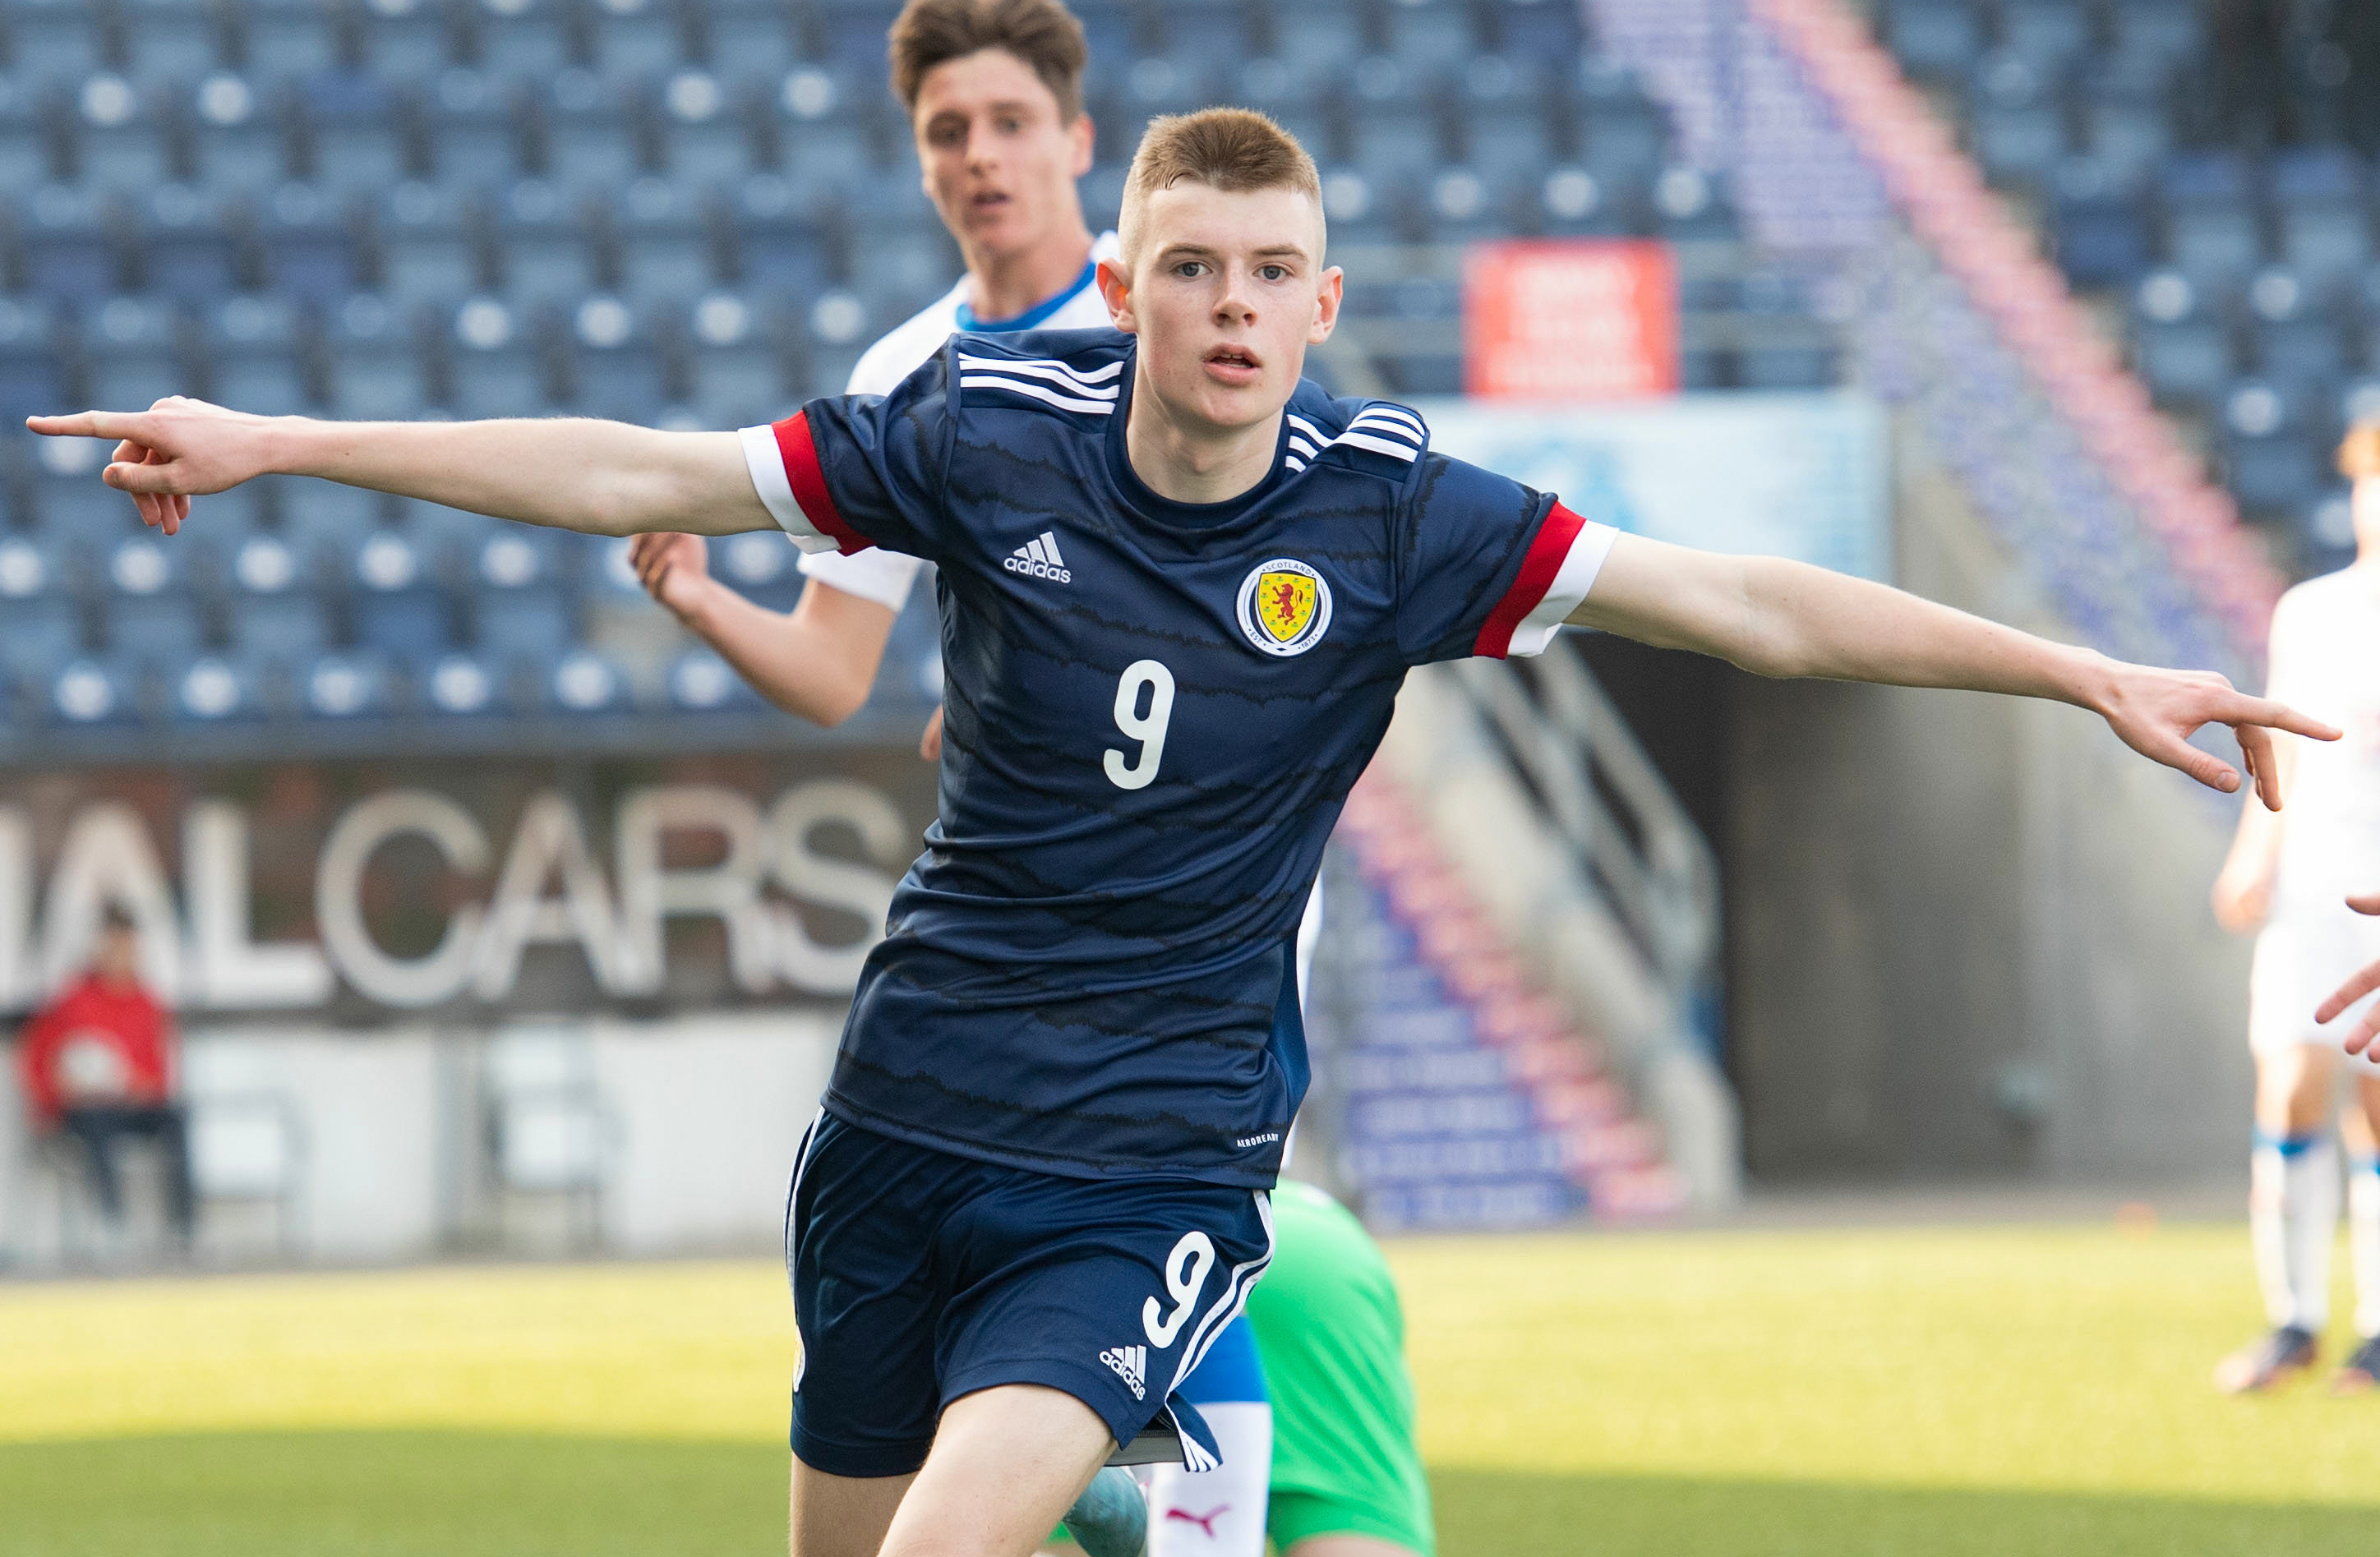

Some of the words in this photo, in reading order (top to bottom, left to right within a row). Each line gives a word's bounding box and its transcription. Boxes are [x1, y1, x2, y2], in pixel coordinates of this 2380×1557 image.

[1003, 557, 1072, 584] adidas
[1266, 562, 1312, 575] SCOTLAND
[1103, 659, 1176, 790] 9
[1142, 1231, 1215, 1349] 9
[1099, 1351, 1146, 1401] adidas
